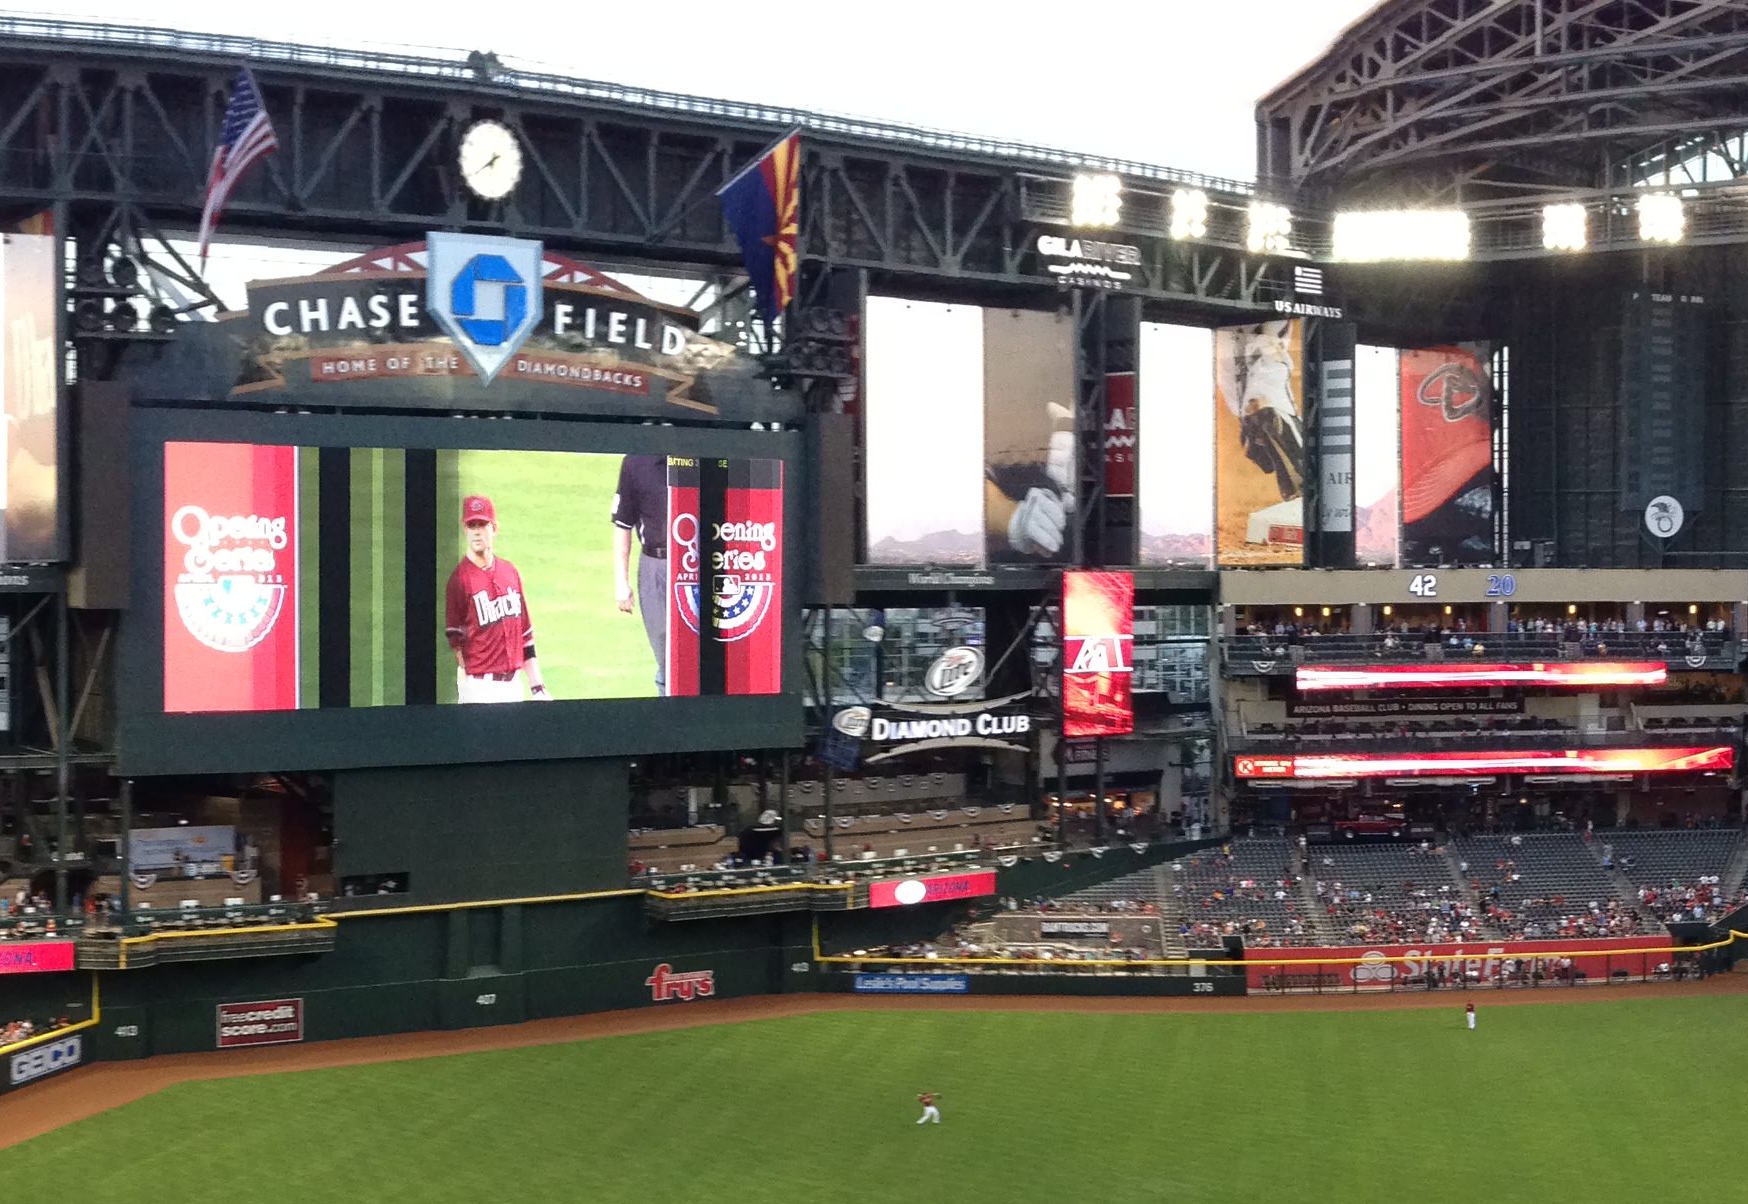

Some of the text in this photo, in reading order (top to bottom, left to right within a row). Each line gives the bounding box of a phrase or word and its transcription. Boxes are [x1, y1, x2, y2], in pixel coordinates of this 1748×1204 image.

[1274, 300, 1342, 319] US AIRWAYS
[263, 294, 686, 356] CHASE FIELD
[322, 354, 643, 388] HOME OF THE DIAMONDBACKS
[1409, 574, 1437, 596] 42
[1485, 573, 1516, 596] 20
[1293, 704, 1331, 714] ARIZONA
[1332, 702, 1377, 713] BASEBALL
[1378, 702, 1400, 712] CLUB
[1407, 702, 1439, 712] DINING
[1440, 702, 1465, 711] OPEN
[1478, 702, 1495, 711] ALL
[871, 713, 1031, 741] DIAMOND CLUB
[645, 963, 715, 1001] fry's
[220, 1005, 295, 1024] freecredit
[220, 1021, 298, 1038] score.com
[11, 1039, 80, 1083] GEICO
